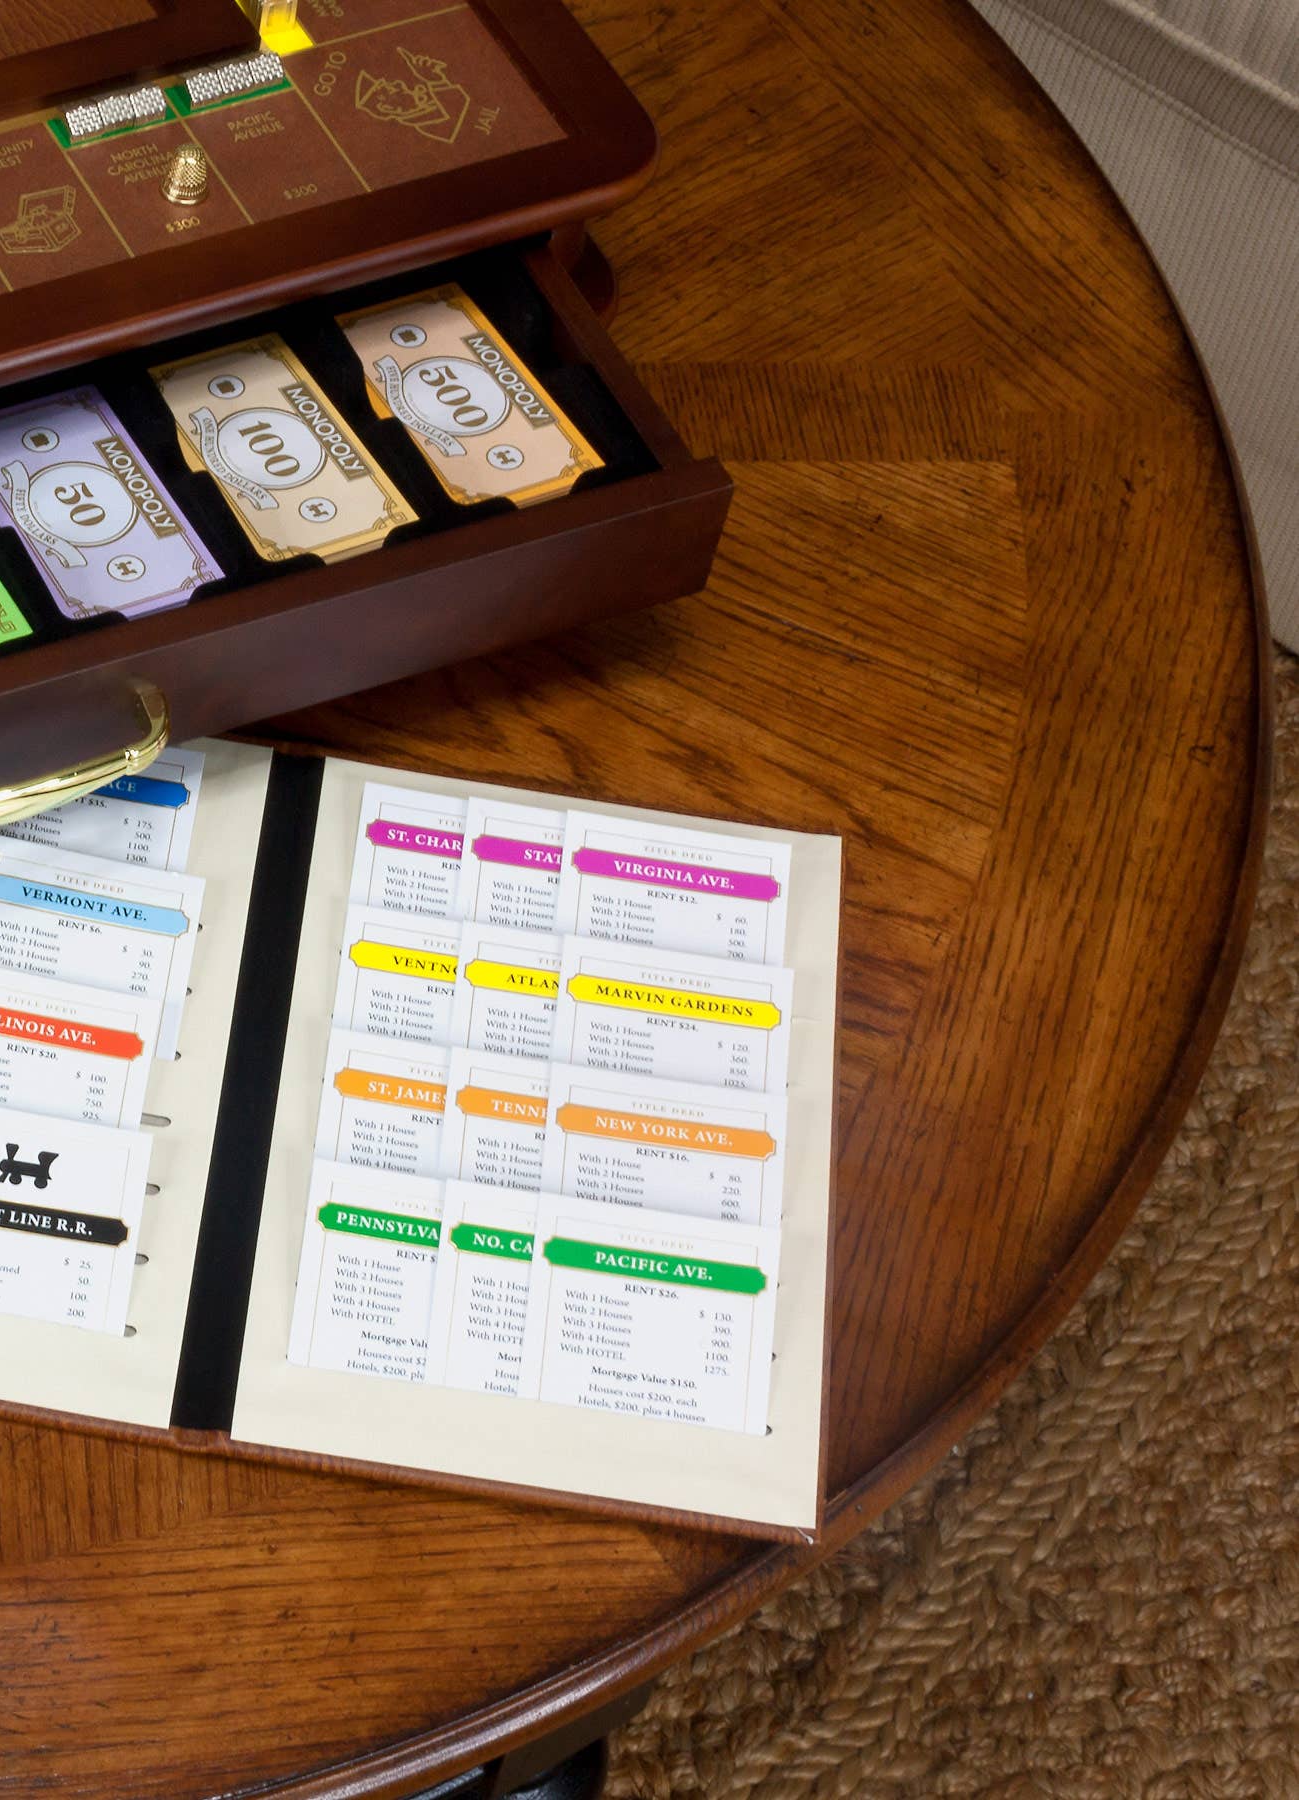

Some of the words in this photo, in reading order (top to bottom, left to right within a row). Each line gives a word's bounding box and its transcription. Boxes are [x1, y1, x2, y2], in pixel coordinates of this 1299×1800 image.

[313, 72, 336, 97] GO
[325, 51, 347, 70] TO
[226, 111, 276, 132] PACIFIC
[474, 106, 500, 135] JAIL
[234, 121, 285, 143] AVENUE
[110, 144, 158, 163] NORTH
[283, 183, 318, 200] $300
[166, 216, 200, 232] $300
[470, 337, 549, 420] MONOPOLY
[419, 365, 488, 427] 500
[288, 386, 365, 471] MONOPOLY
[238, 420, 300, 477] 100
[102, 440, 176, 529] MONOPOLY
[54, 482, 106, 526] 50
[387, 829, 410, 843] ST.
[614, 860, 694, 883] VIRGINIA
[699, 874, 735, 890] AVE.
[22, 885, 108, 912] VERMONT
[111, 906, 148, 921] AVE.
[647, 890, 676, 902] RENT
[58, 918, 88, 931] RENT
[596, 984, 665, 1005] MARVIN
[671, 997, 754, 1017] GARDENS
[647, 1017, 676, 1029] RENT
[59, 1025, 97, 1046] AVE.
[7, 1043, 37, 1056] RENT
[368, 1082, 391, 1095] ST.
[595, 1115, 638, 1132] NEW
[641, 1123, 689, 1140] YORK
[695, 1131, 733, 1146] AVE.
[636, 1147, 666, 1159] RENT
[9, 1210, 52, 1229] LINE
[56, 1218, 93, 1236] R.R.
[473, 1233, 504, 1249] NO.
[595, 1251, 669, 1274] PACIFIC
[674, 1266, 713, 1281] AVE.
[625, 1283, 655, 1296] RENT
[591, 1366, 639, 1382] Mortgage
[641, 1374, 667, 1385] Value
